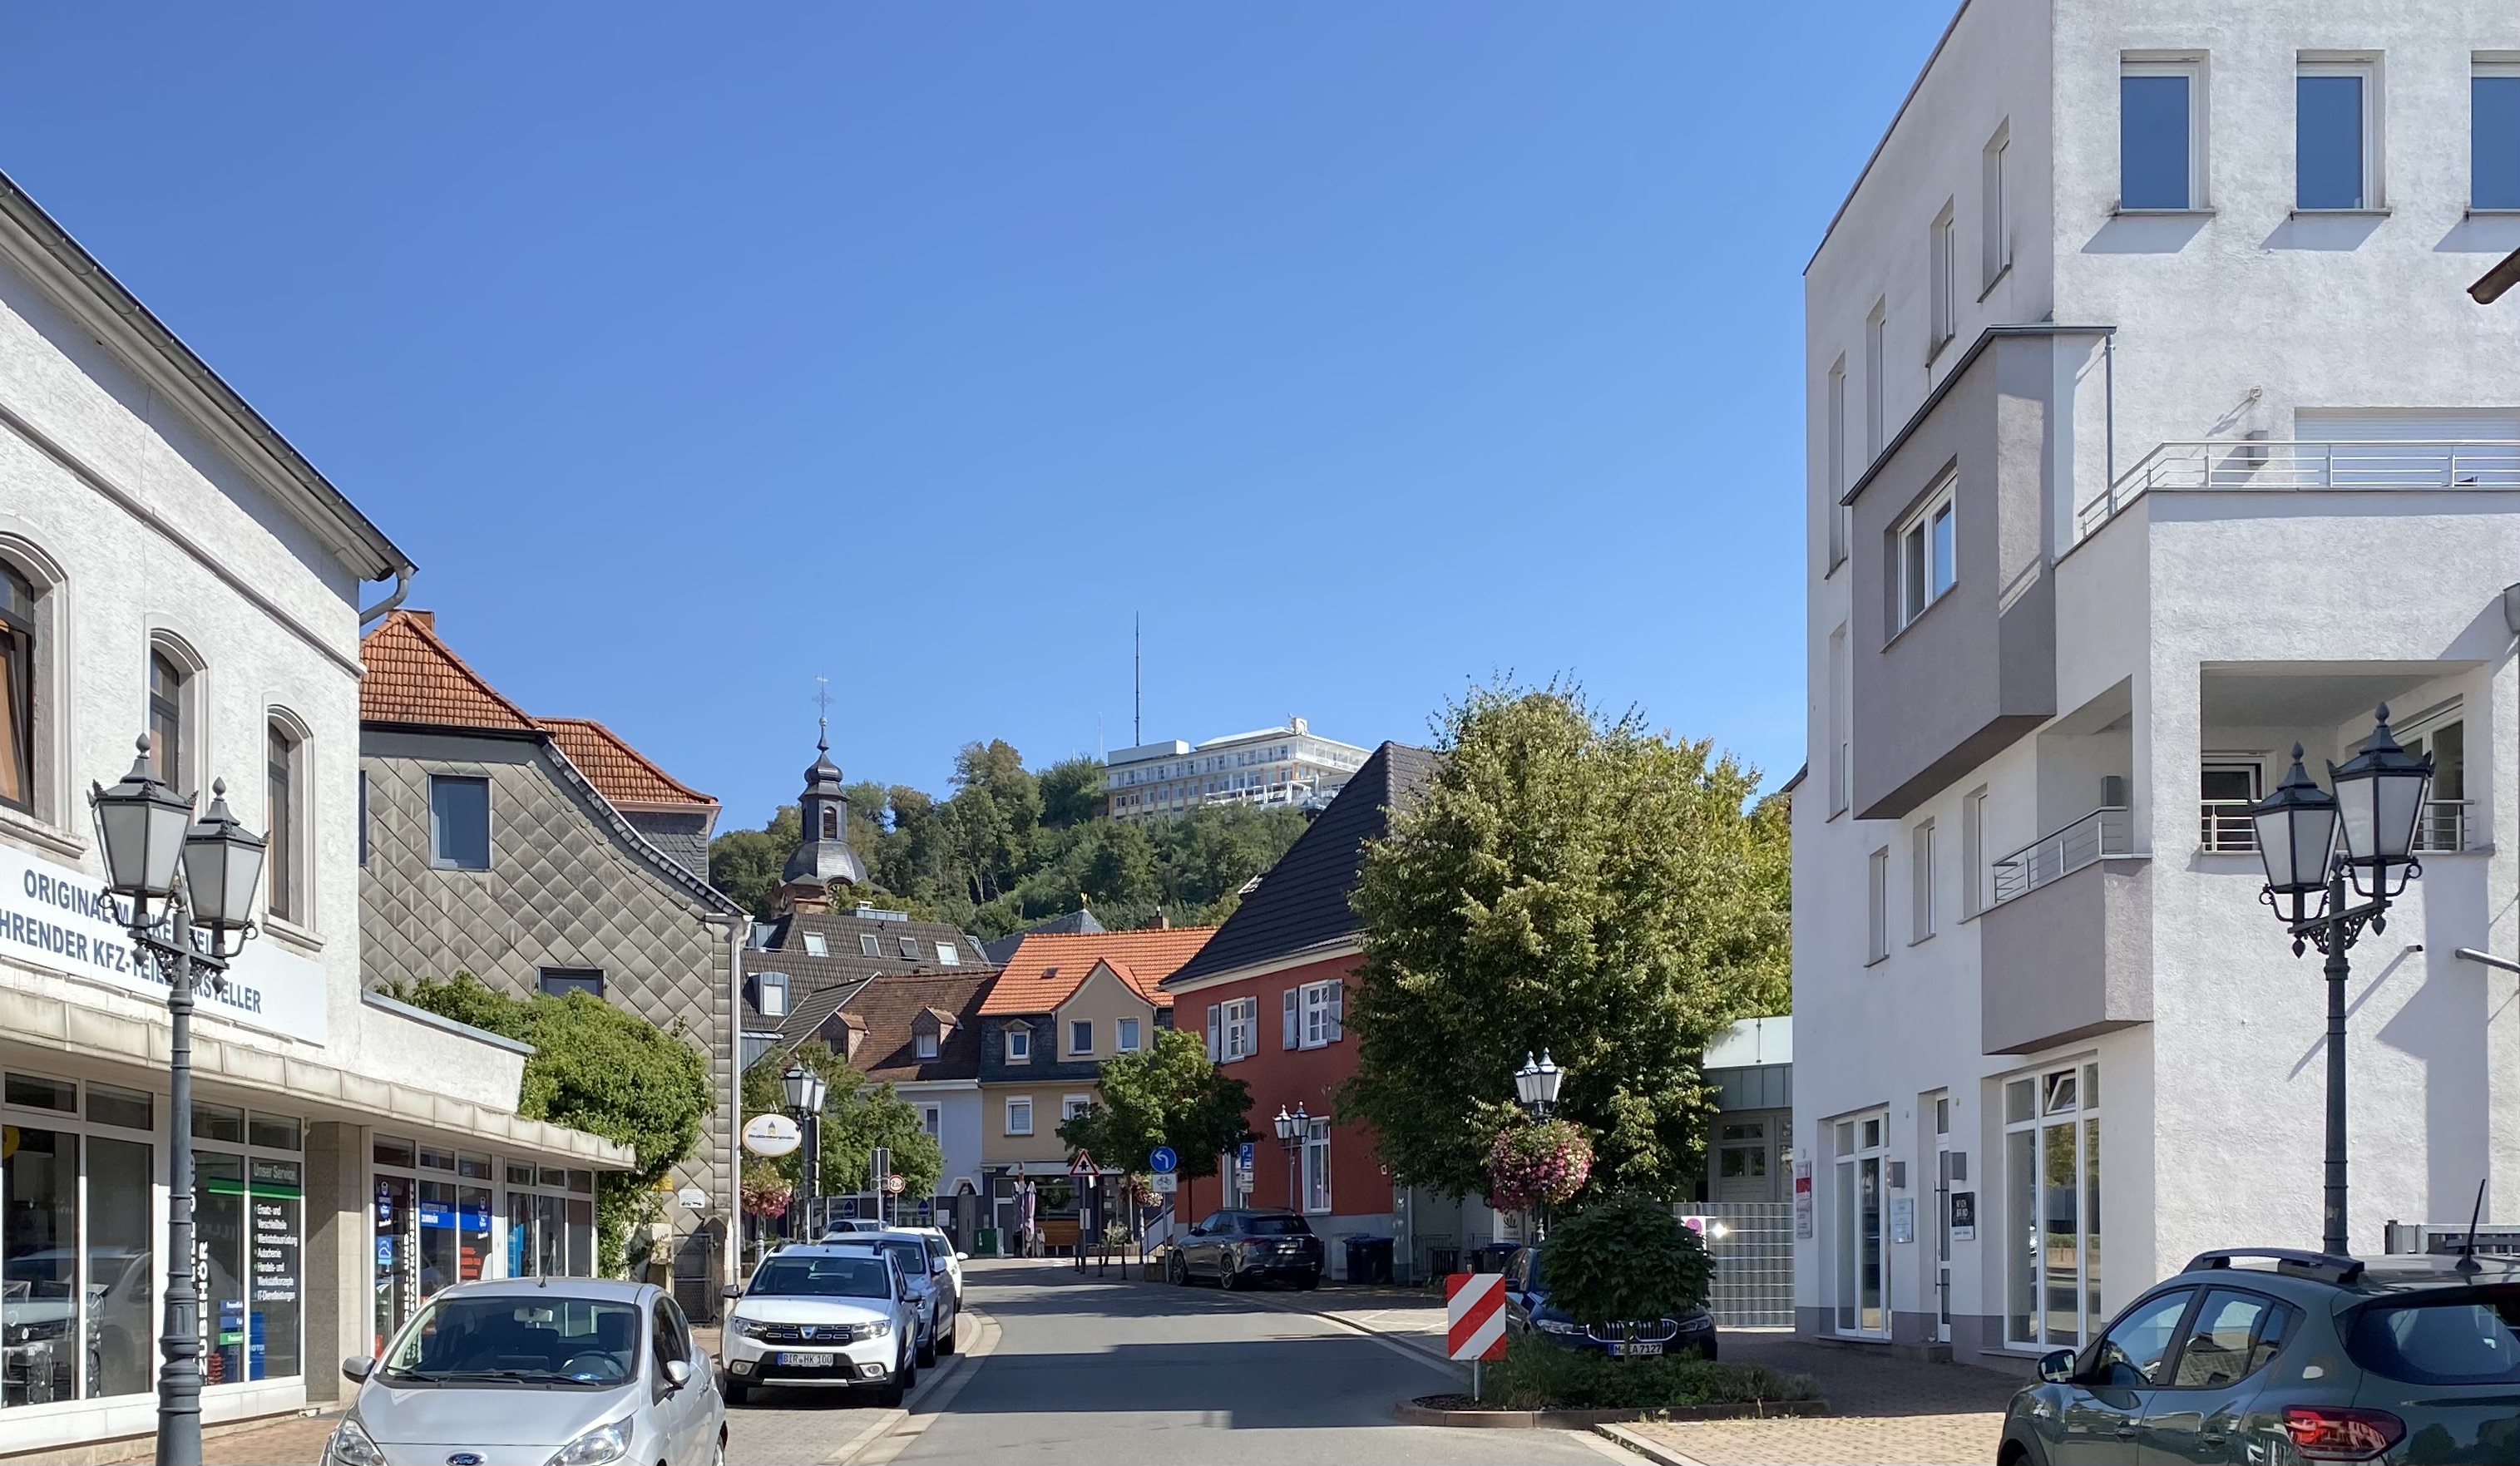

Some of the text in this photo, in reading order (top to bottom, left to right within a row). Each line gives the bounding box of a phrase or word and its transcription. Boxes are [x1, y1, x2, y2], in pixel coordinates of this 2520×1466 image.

[1242, 1145, 1248, 1157] P
[274, 1165, 295, 1180] Service
[198, 1241, 208, 1375] ZUBEHÖR
[1639, 1344, 1662, 1354] 7127
[783, 1354, 833, 1364] BIR HK 100
